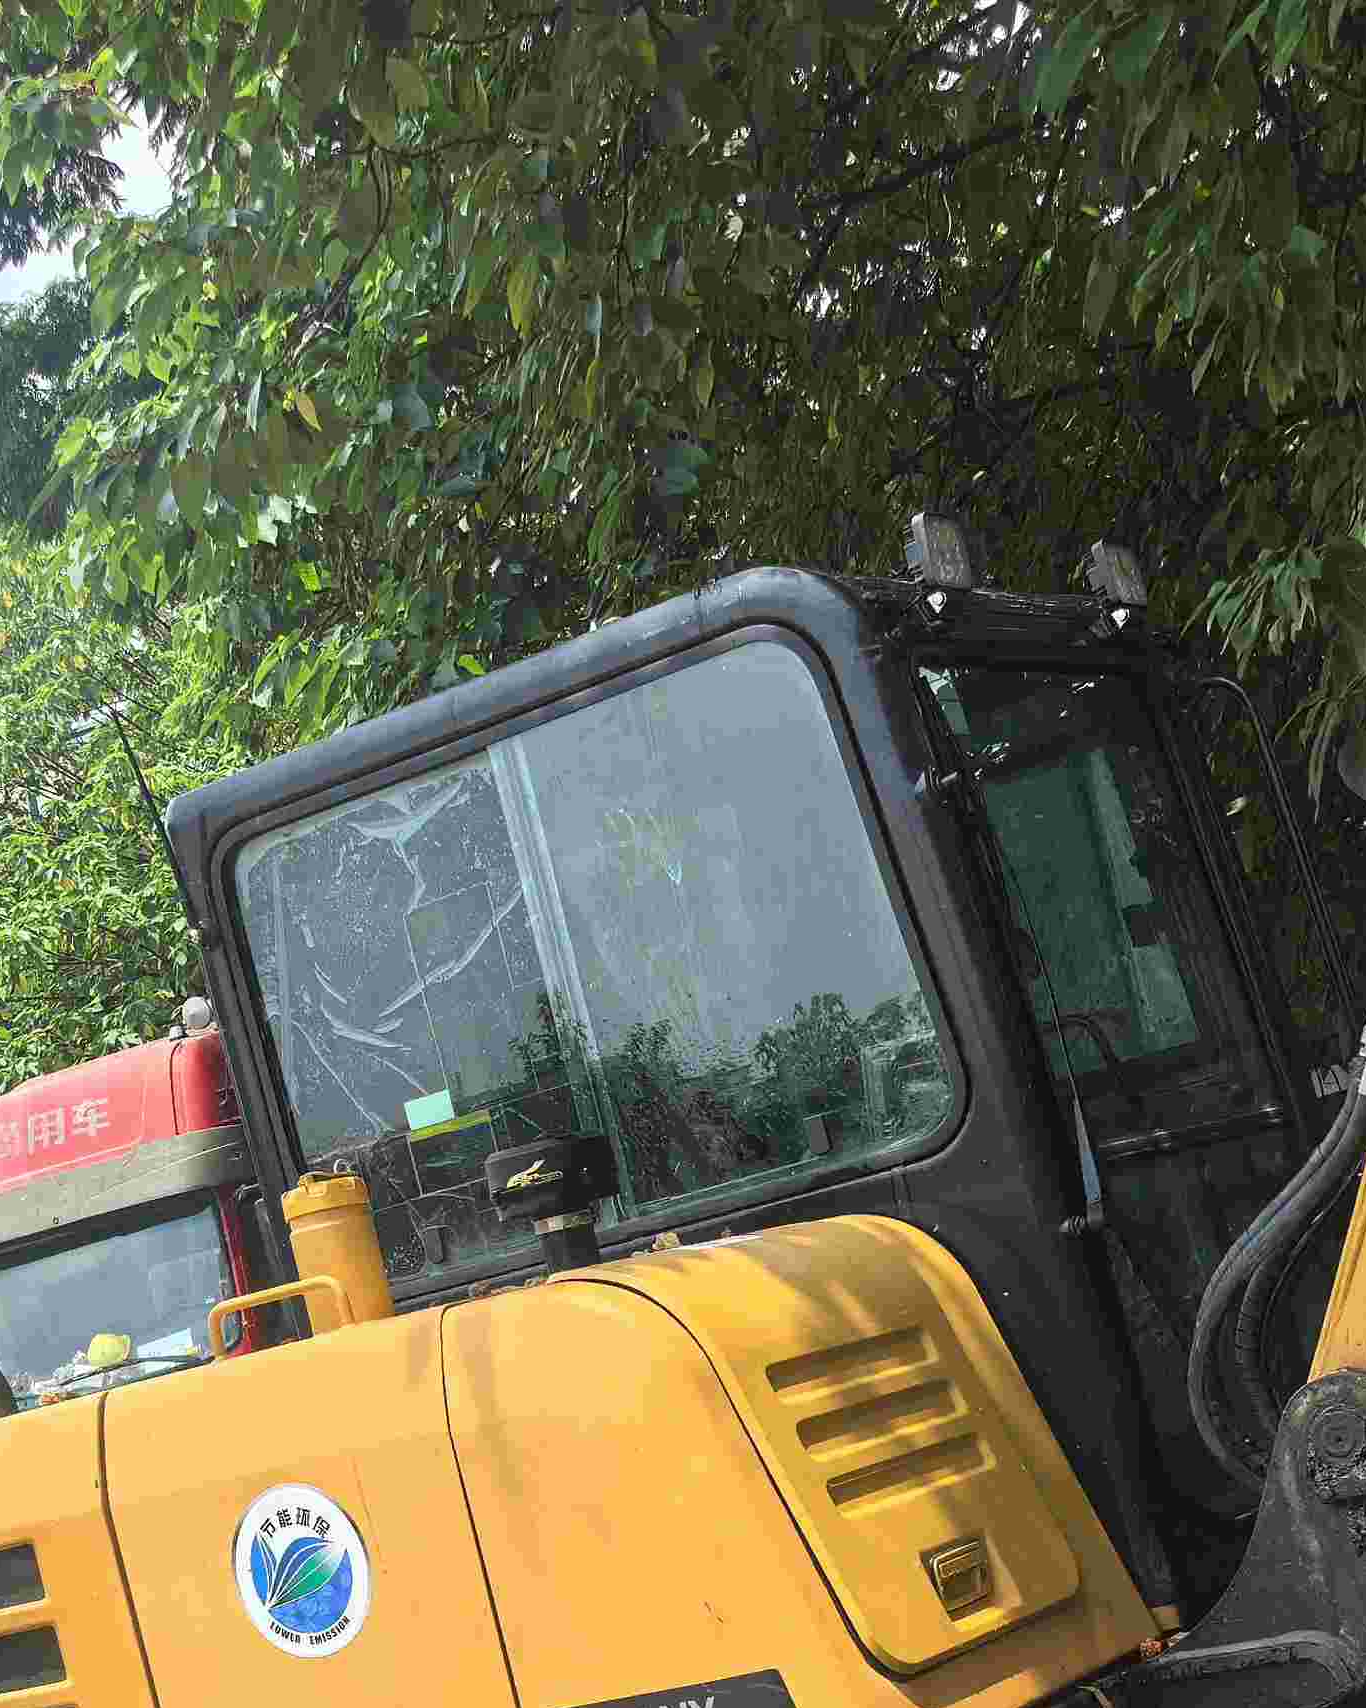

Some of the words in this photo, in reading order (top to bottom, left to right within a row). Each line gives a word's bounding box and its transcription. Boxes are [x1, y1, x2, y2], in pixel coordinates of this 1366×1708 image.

[260, 1506, 332, 1538] 节能环保
[269, 1620, 302, 1645] LOWER
[309, 1615, 352, 1646] EMISSION
